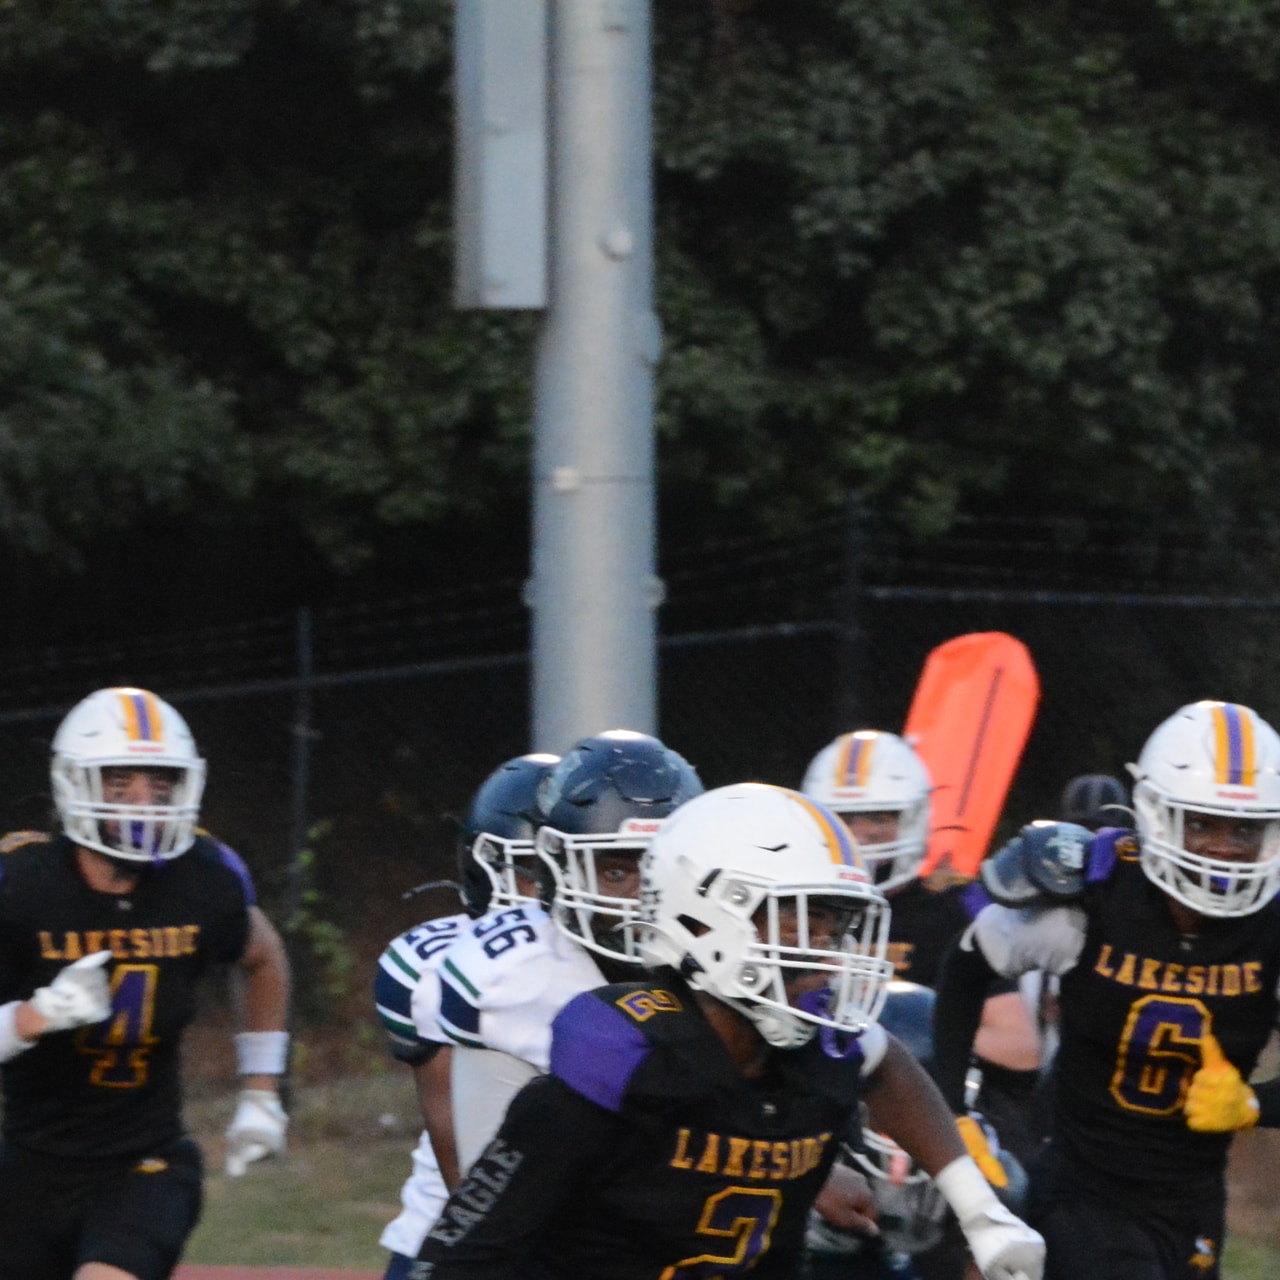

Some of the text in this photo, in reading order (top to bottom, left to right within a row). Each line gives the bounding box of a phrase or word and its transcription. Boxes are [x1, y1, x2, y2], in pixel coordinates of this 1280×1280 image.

[38, 924, 200, 960] LAKESIDE
[473, 908, 536, 959] 56
[1095, 945, 1263, 995] LAKESIDE
[74, 964, 160, 1088] 4
[616, 989, 684, 1022] 2
[1110, 994, 1214, 1116] 6
[670, 1128, 832, 1181] LAKESIDE
[427, 1138, 525, 1247] EAGLE
